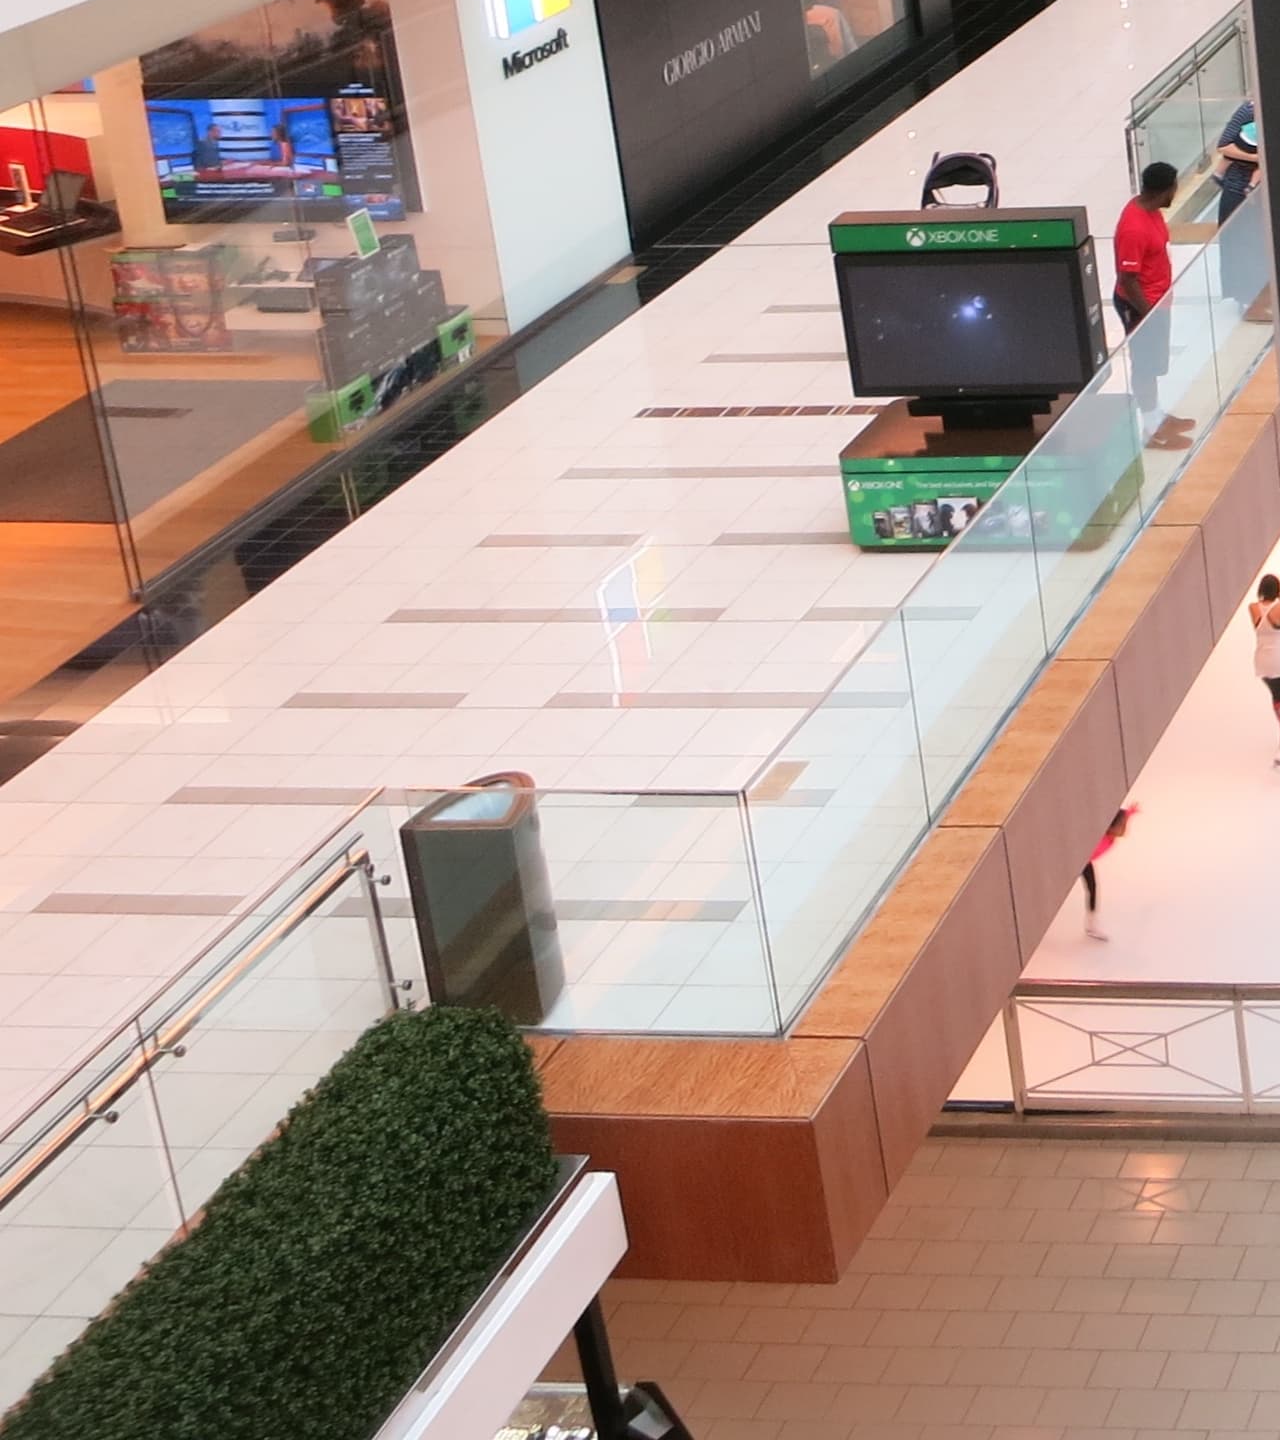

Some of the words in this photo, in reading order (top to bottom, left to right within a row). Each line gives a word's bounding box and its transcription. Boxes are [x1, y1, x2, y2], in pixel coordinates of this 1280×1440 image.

[502, 27, 570, 80] Microsoft
[663, 38, 715, 86] GIORGIO
[718, 10, 762, 55] ARMANI
[928, 230, 967, 244] XBOX
[967, 229, 999, 243] ONE
